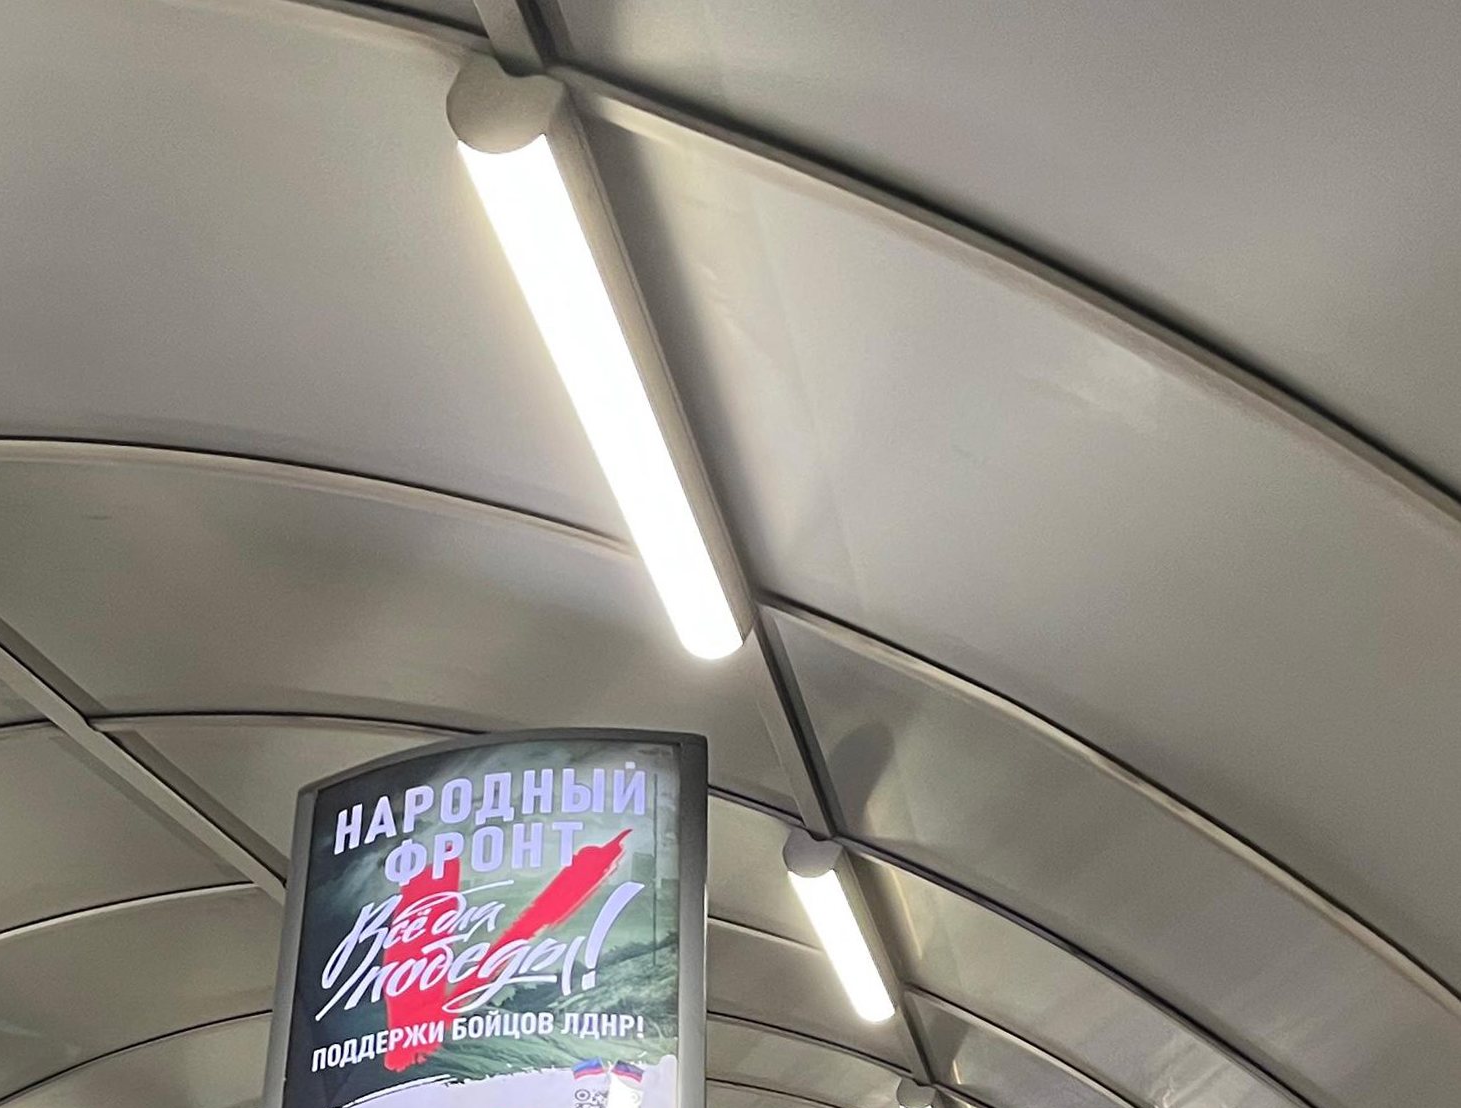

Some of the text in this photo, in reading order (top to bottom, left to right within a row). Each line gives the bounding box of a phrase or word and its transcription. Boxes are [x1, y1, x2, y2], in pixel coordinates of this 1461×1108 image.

[333, 760, 646, 855] НАРОДНЫЙ
[384, 821, 584, 886] ФРОНТ
[310, 1010, 645, 1073] ПОДДЕРЖИ БОЙЦОВ ЛДНР!
